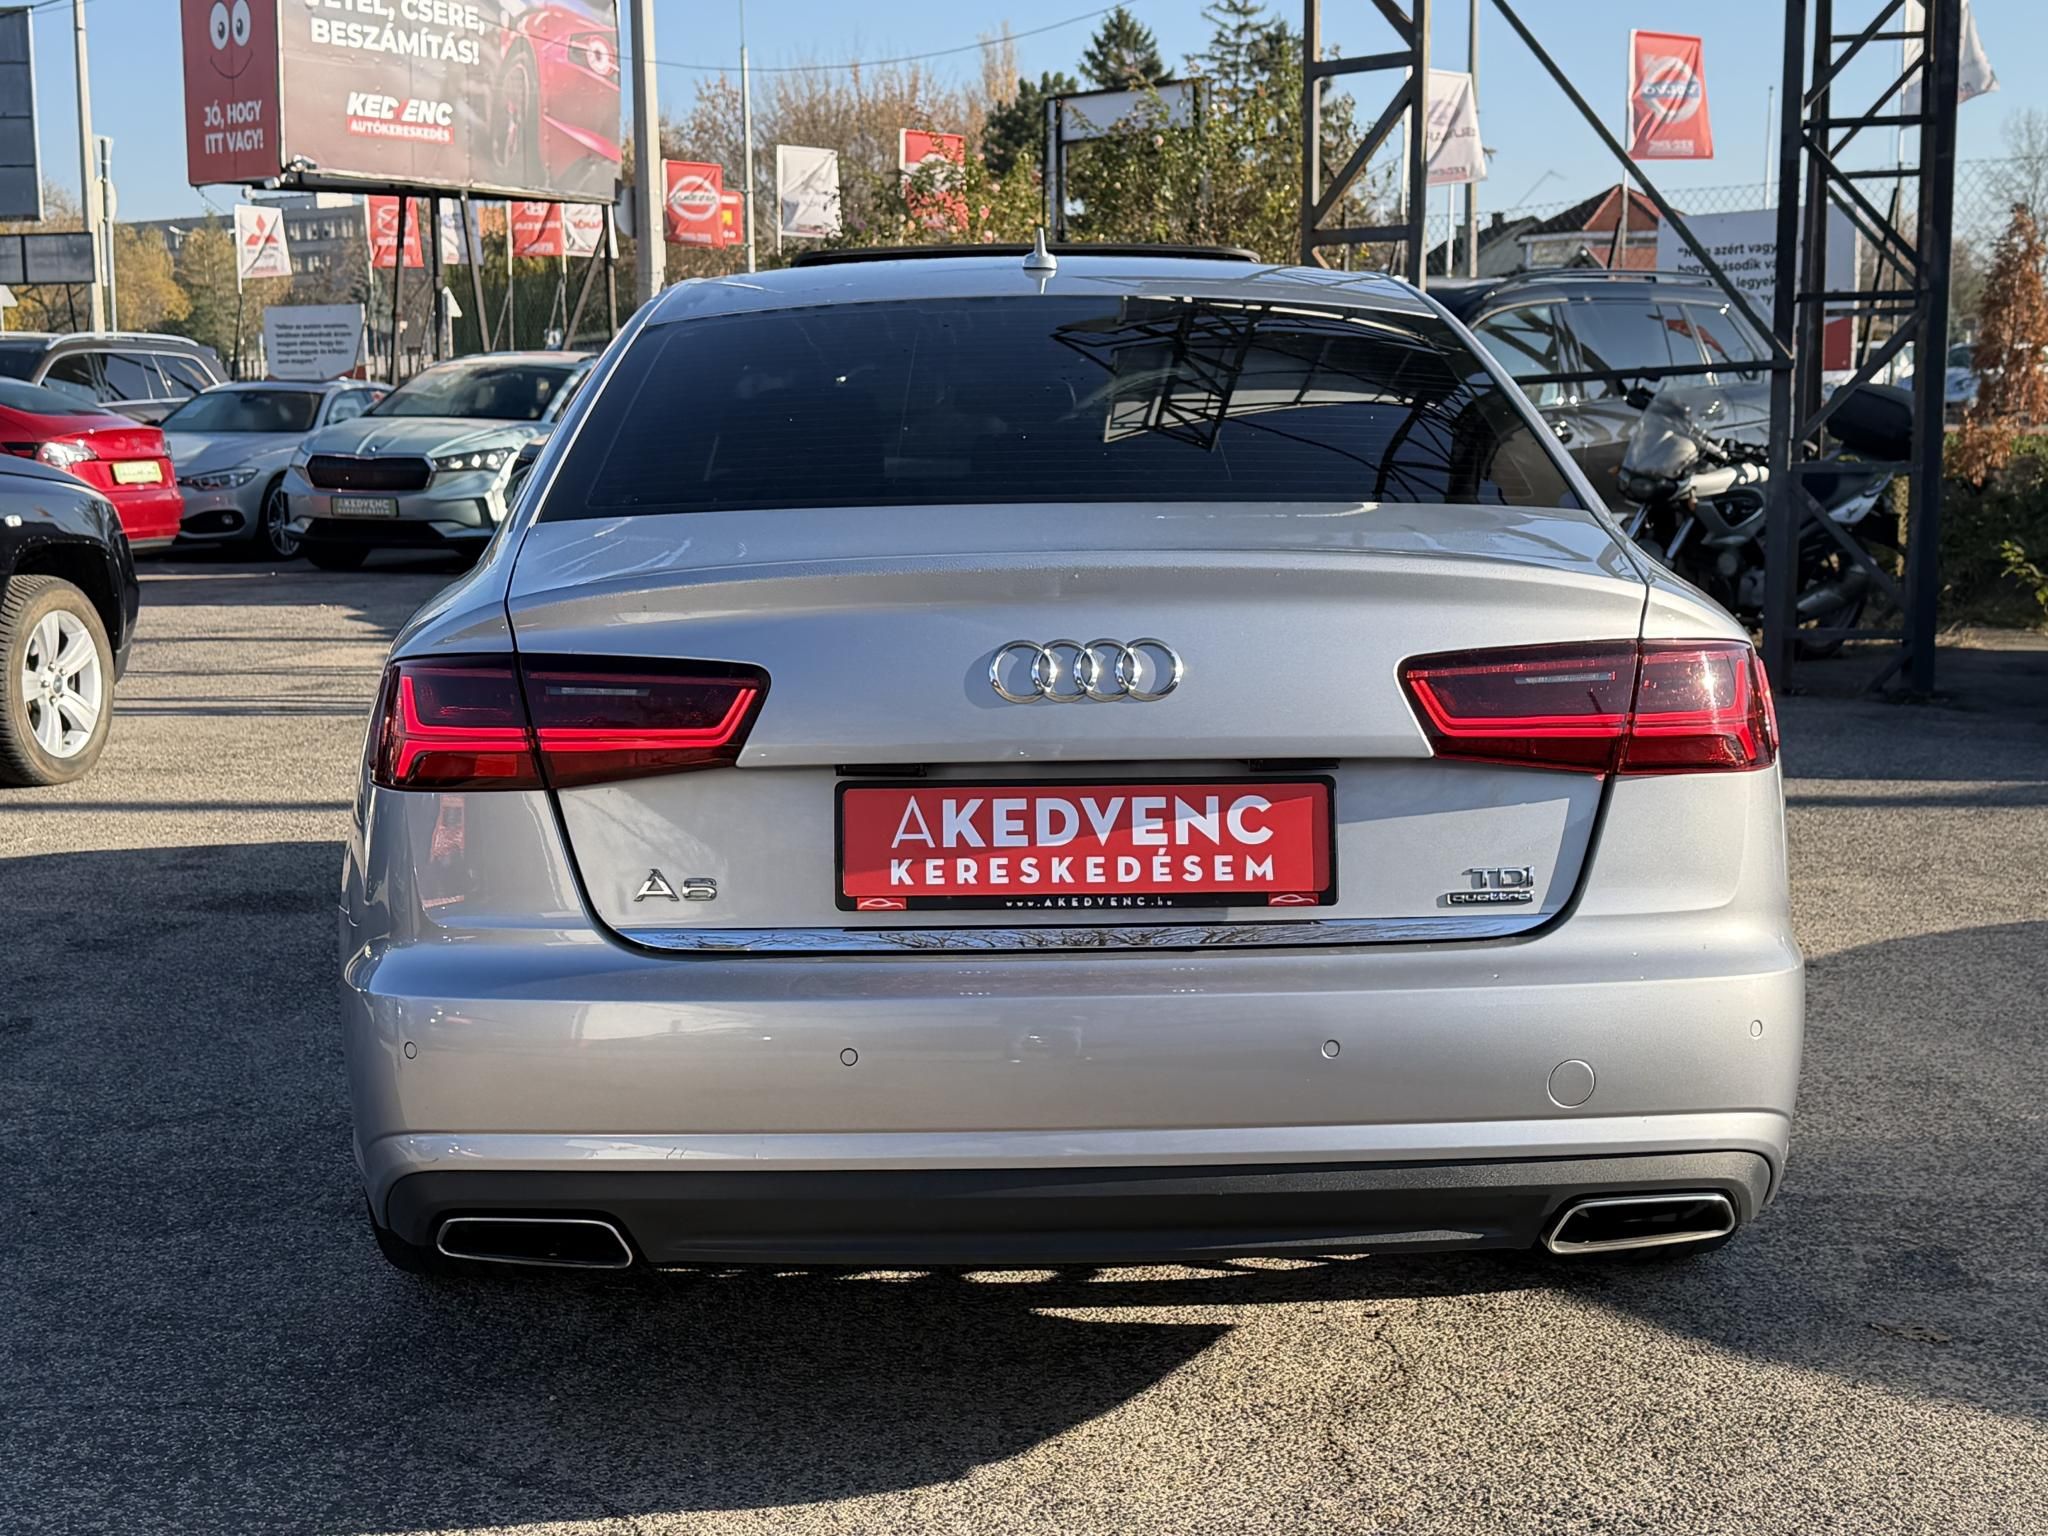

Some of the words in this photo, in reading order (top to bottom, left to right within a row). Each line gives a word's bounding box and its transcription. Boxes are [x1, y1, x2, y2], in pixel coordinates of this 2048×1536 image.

[400, 0, 485, 35] CSERE,
[311, 18, 480, 65] BESZÁMÍTÁS!
[204, 99, 225, 129] JÓ,
[226, 99, 262, 124] HOGY
[205, 132, 224, 154] ITT
[226, 128, 264, 152] VAGY!
[891, 795, 1274, 848] AKEDVENC
[890, 847, 1274, 885] KERESKEDÉSEM
[1468, 866, 1535, 889] TDI
[634, 868, 717, 901] A6
[1452, 892, 1531, 904] quattro
